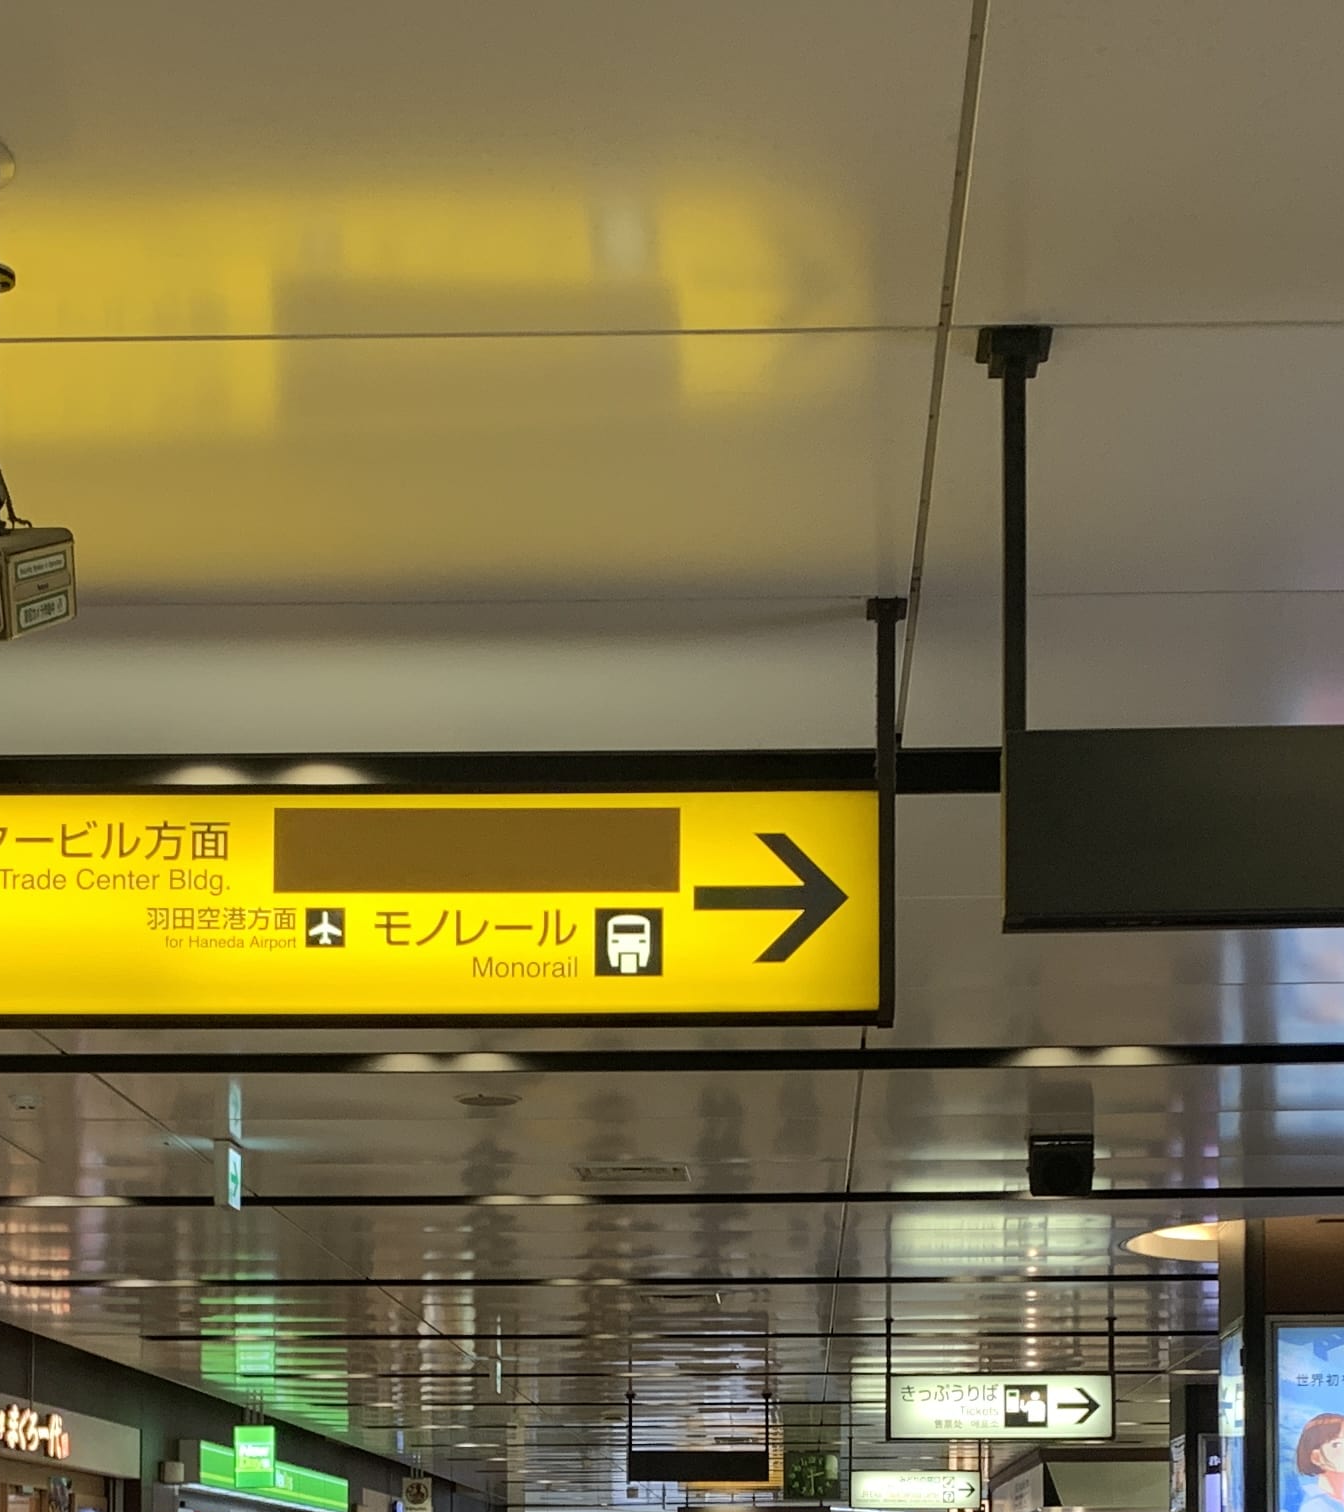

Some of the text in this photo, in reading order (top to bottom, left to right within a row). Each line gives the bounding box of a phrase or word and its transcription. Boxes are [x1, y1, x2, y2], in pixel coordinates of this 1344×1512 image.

[0, 868, 67, 890] Trade
[76, 868, 160, 891] Center
[169, 868, 232, 897] Bldg.
[146, 906, 297, 931] 羽田空港方面
[374, 908, 577, 948] モノレール
[165, 935, 297, 952] for Haneda Airport
[473, 956, 578, 979] Monorail
[900, 1384, 999, 1403] きっぷうりば
[960, 1405, 999, 1417] Tickets
